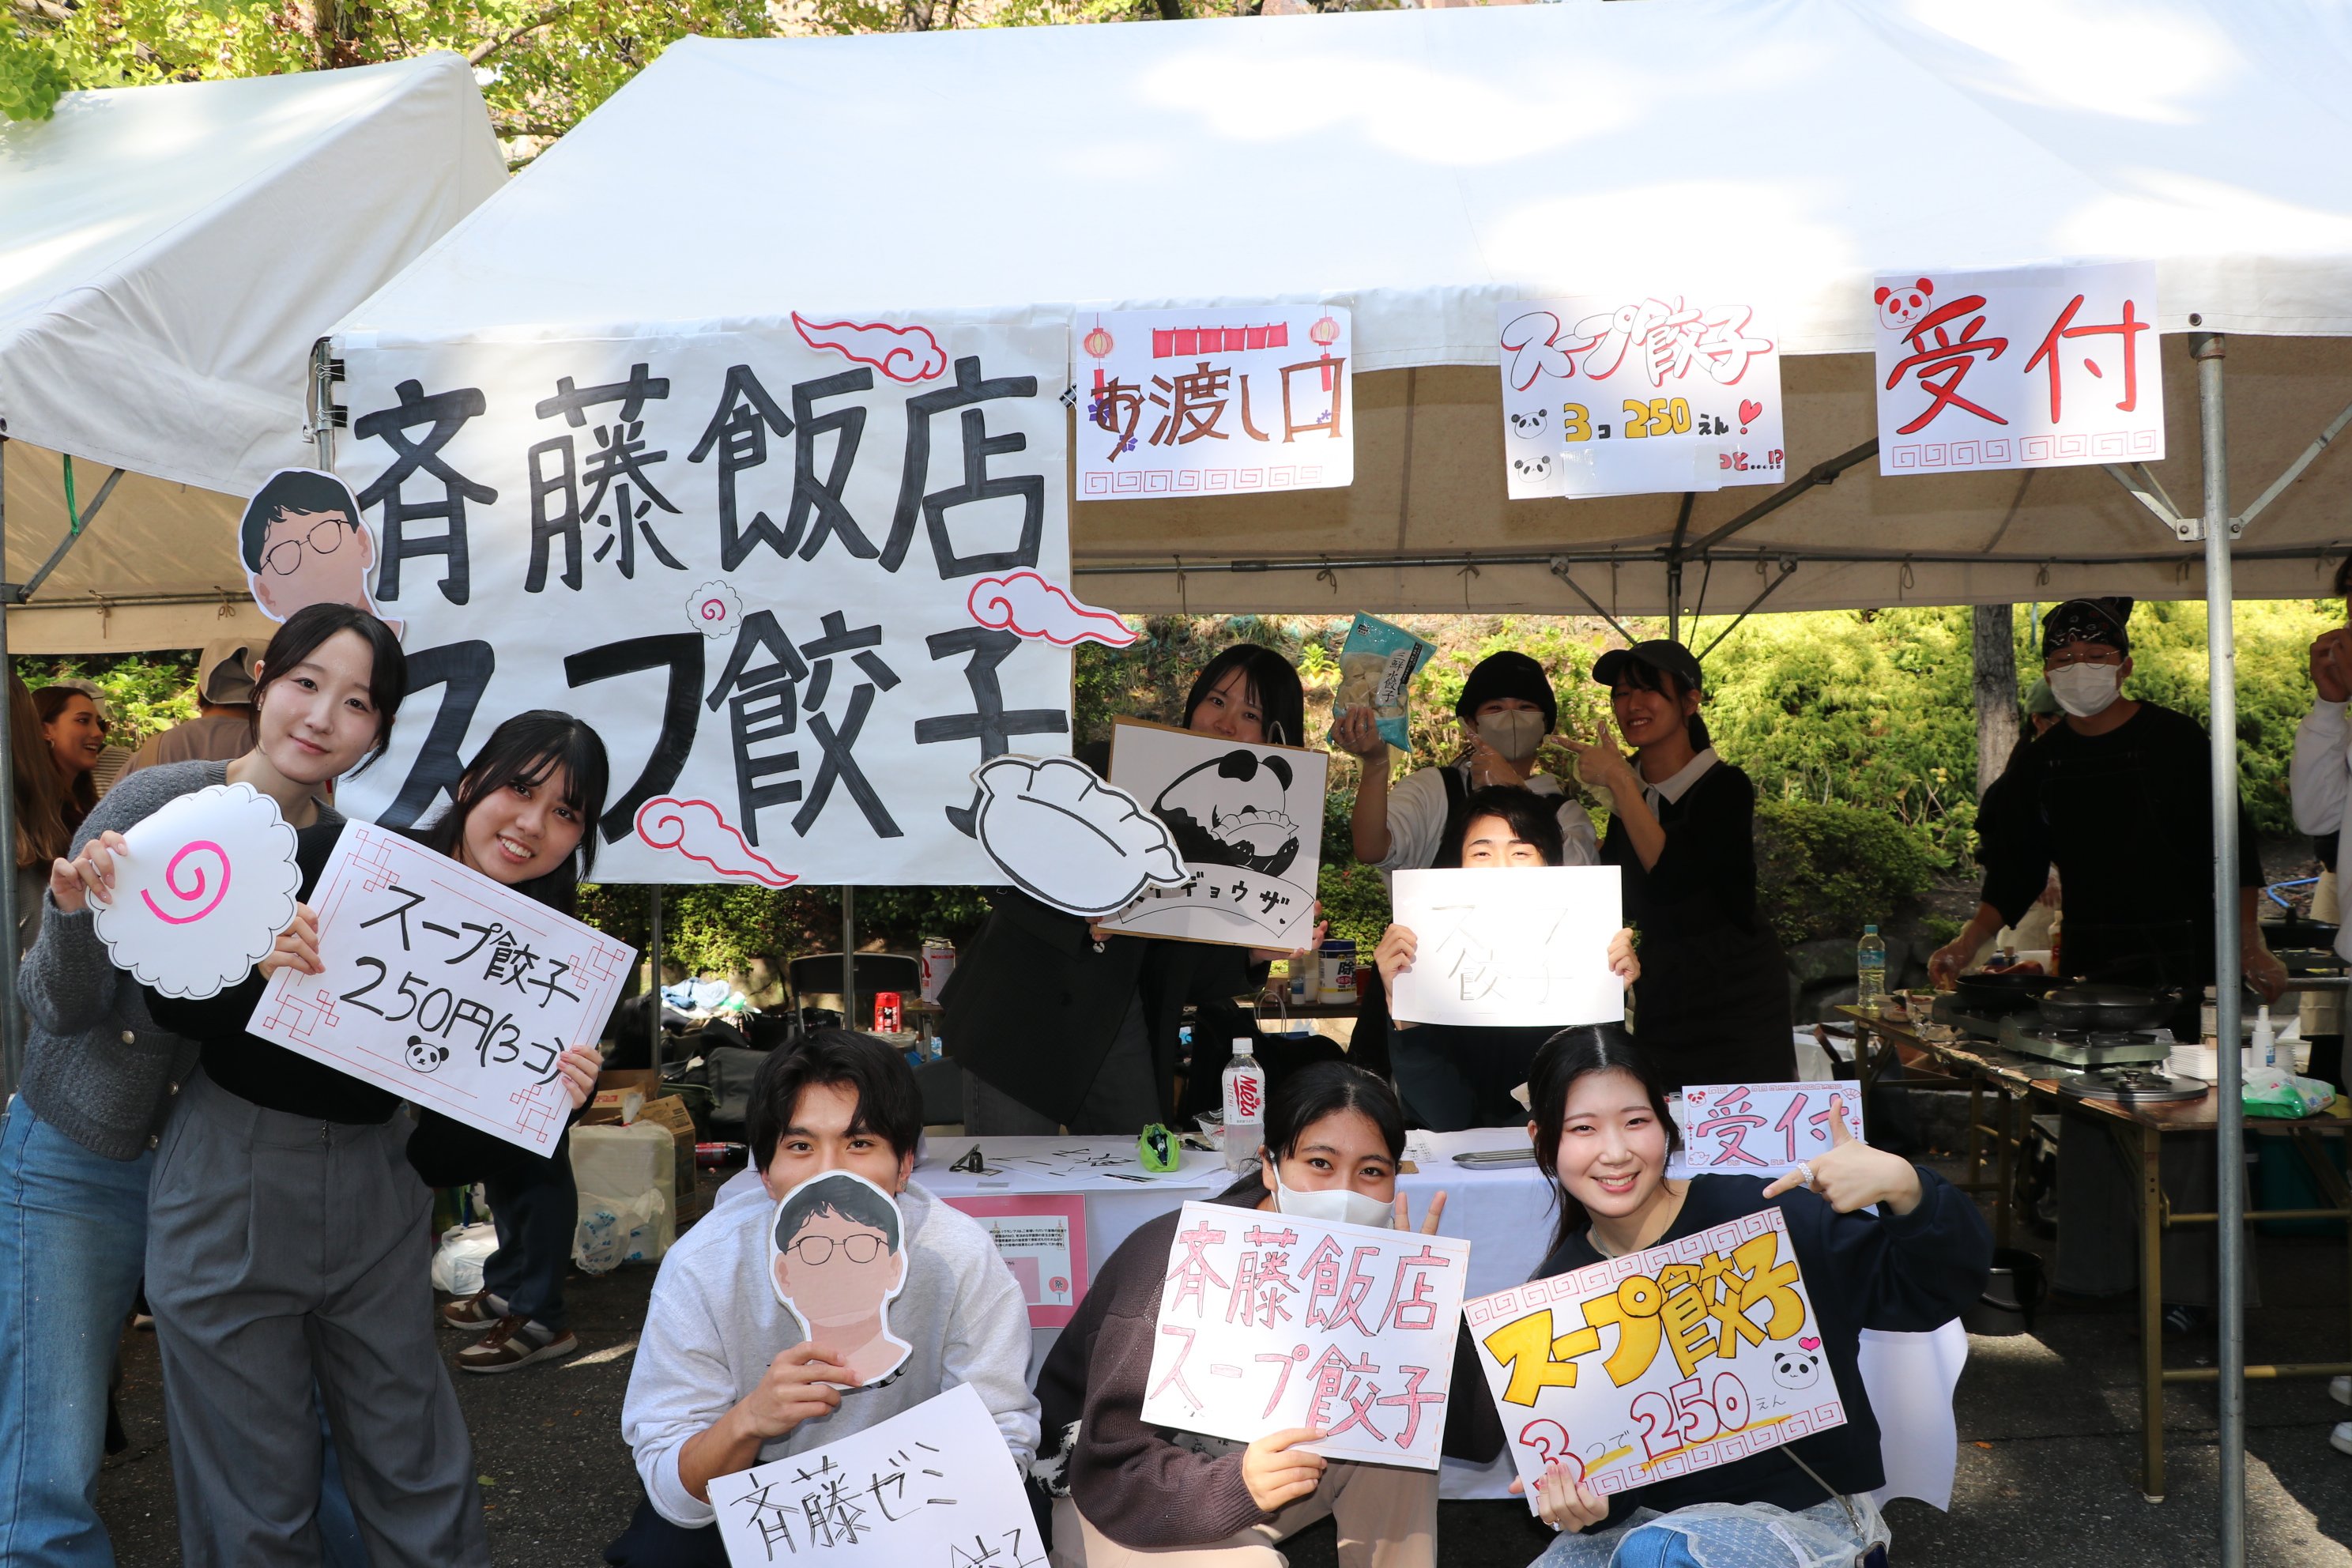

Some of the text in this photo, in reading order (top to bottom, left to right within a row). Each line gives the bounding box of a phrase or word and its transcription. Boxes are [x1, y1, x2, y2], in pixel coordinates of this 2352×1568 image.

[1501, 296, 1773, 391] スープ餃子
[1886, 295, 2150, 434] 受付
[1090, 358, 1347, 462] お渡し口
[1623, 398, 1729, 439] 250えん
[354, 356, 1045, 605] 斉藤飯店
[1382, 652, 1406, 703] 三鮮水餃子
[360, 884, 580, 1008] スープ餃子
[1128, 871, 1291, 914] ギョウザ
[340, 956, 565, 1085] 250円(3コ)
[1240, 1075, 1258, 1116] Mets
[1696, 1086, 1849, 1167] 受付
[1166, 1220, 1449, 1337] 斉藤飯店
[1483, 1231, 1805, 1407] スープ餃子
[1152, 1325, 1446, 1451] スープ餃子
[729, 1442, 958, 1562] 斉藤ゼミ
